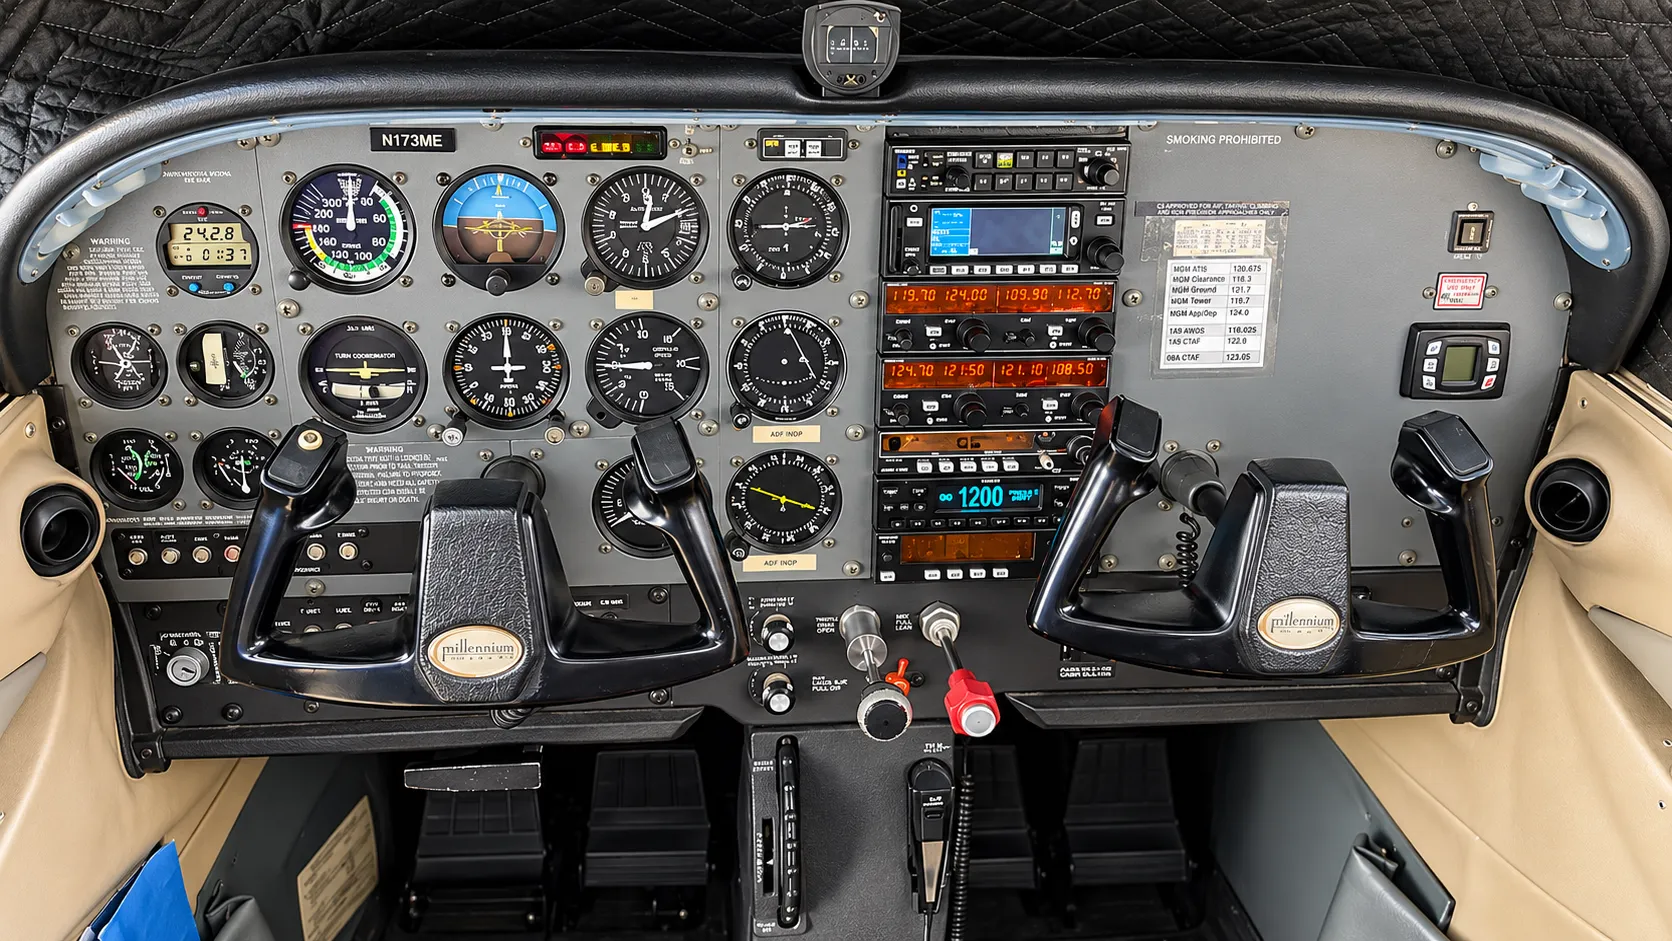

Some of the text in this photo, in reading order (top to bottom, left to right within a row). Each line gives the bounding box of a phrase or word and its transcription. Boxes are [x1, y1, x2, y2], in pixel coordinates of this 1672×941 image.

[382, 134, 443, 147] N173ME
[1166, 135, 1282, 144] SMOKING PROHIBITED
[893, 288, 1100, 301] 119.70 124.00 109.90 112.70
[892, 365, 934, 376] 124.70
[1052, 363, 1093, 375] 108.50
[958, 485, 1003, 507] 1200
[1271, 611, 1334, 633] millennium
[442, 638, 514, 662] millennium
